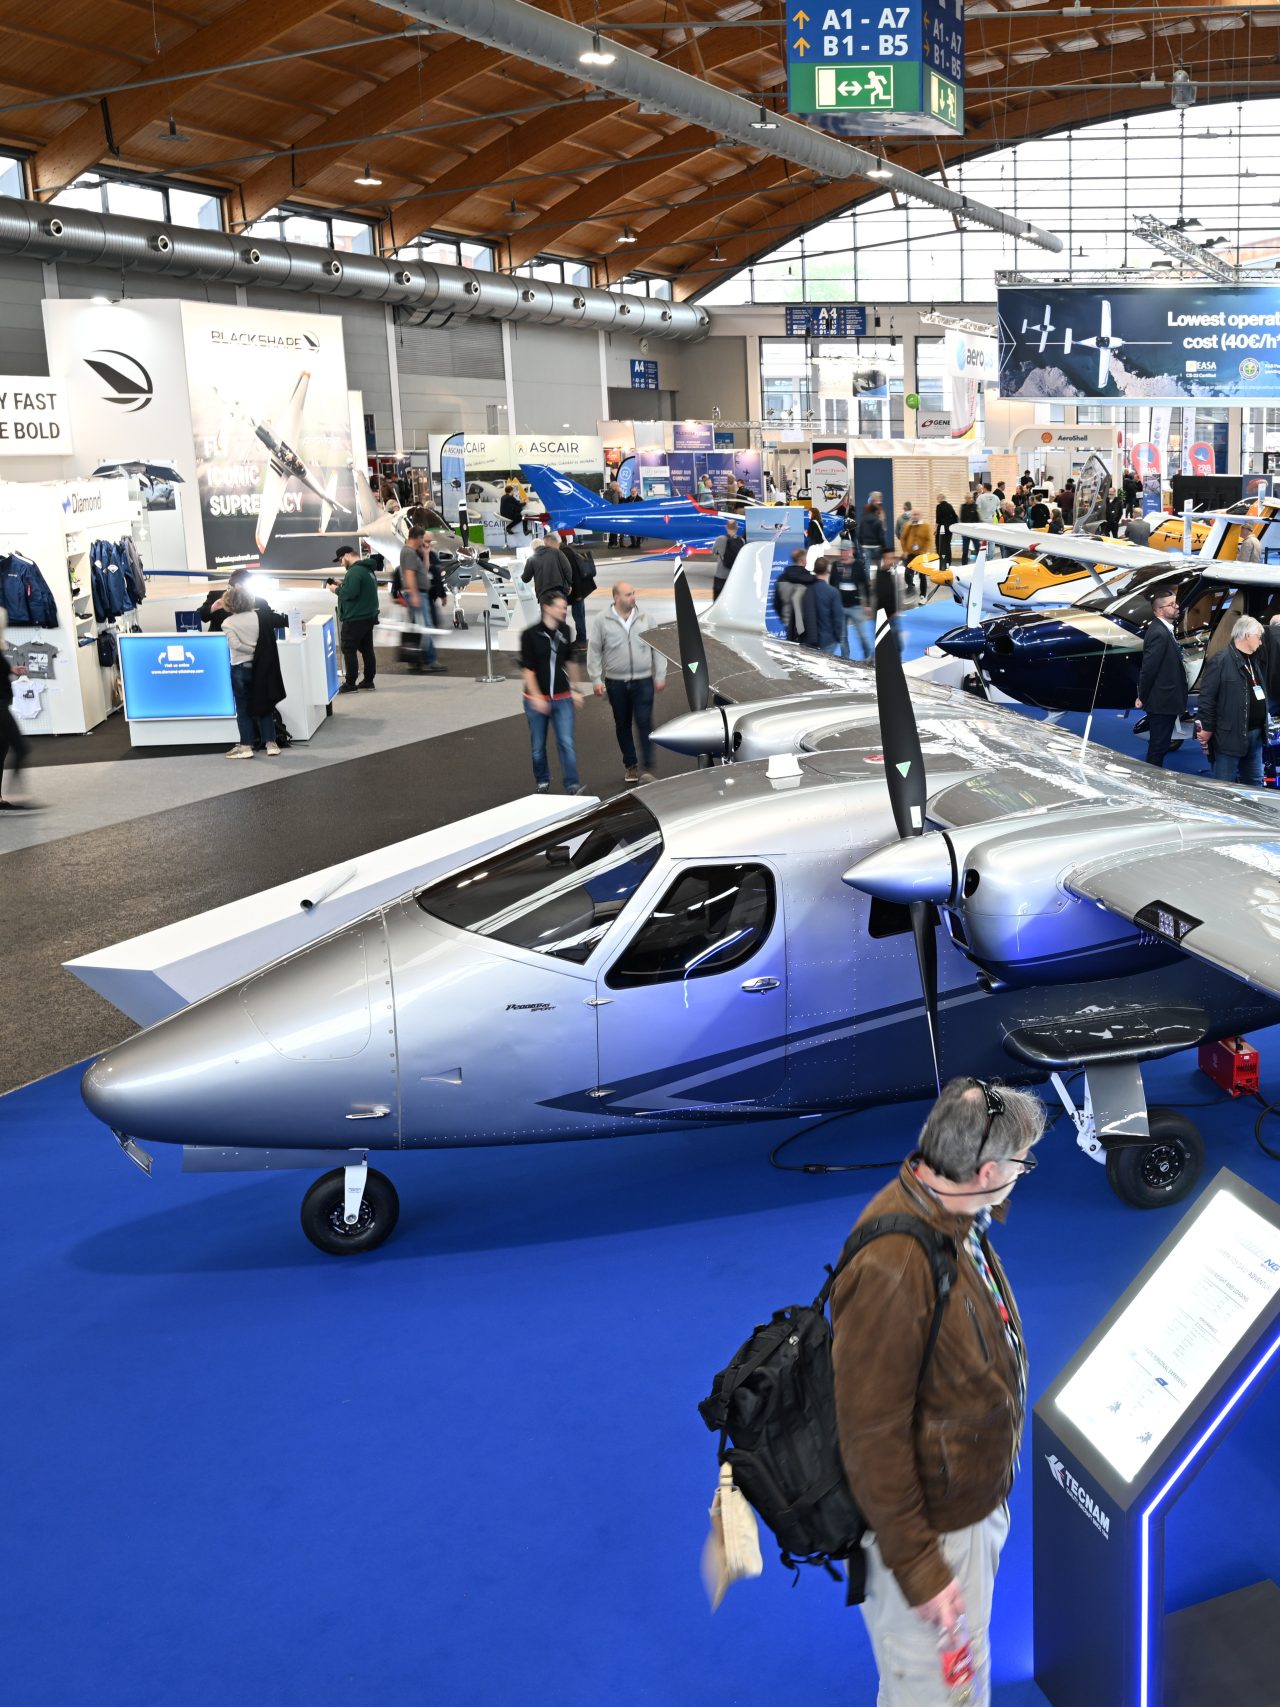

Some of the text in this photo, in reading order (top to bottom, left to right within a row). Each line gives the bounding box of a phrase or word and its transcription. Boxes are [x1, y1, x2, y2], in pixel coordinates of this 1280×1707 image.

[822, 8, 852, 30] A1
[877, 7, 911, 29] A7
[823, 35, 854, 57] B1
[879, 34, 909, 57] B5
[932, 18, 944, 43] A1
[950, 31, 962, 54] A7
[934, 44, 945, 69] B1
[951, 56, 962, 80] B5
[1167, 311, 1226, 327] Lowest
[1182, 333, 1219, 349] cost
[1197, 361, 1217, 370] EASA
[13, 392, 57, 411] FAST
[13, 421, 61, 440] BOLD
[1057, 434, 1088, 442] AeroShell
[529, 442, 579, 454] ASCAIR
[72, 490, 102, 514] Diamond
[1065, 1469, 1110, 1534] TECNAM
